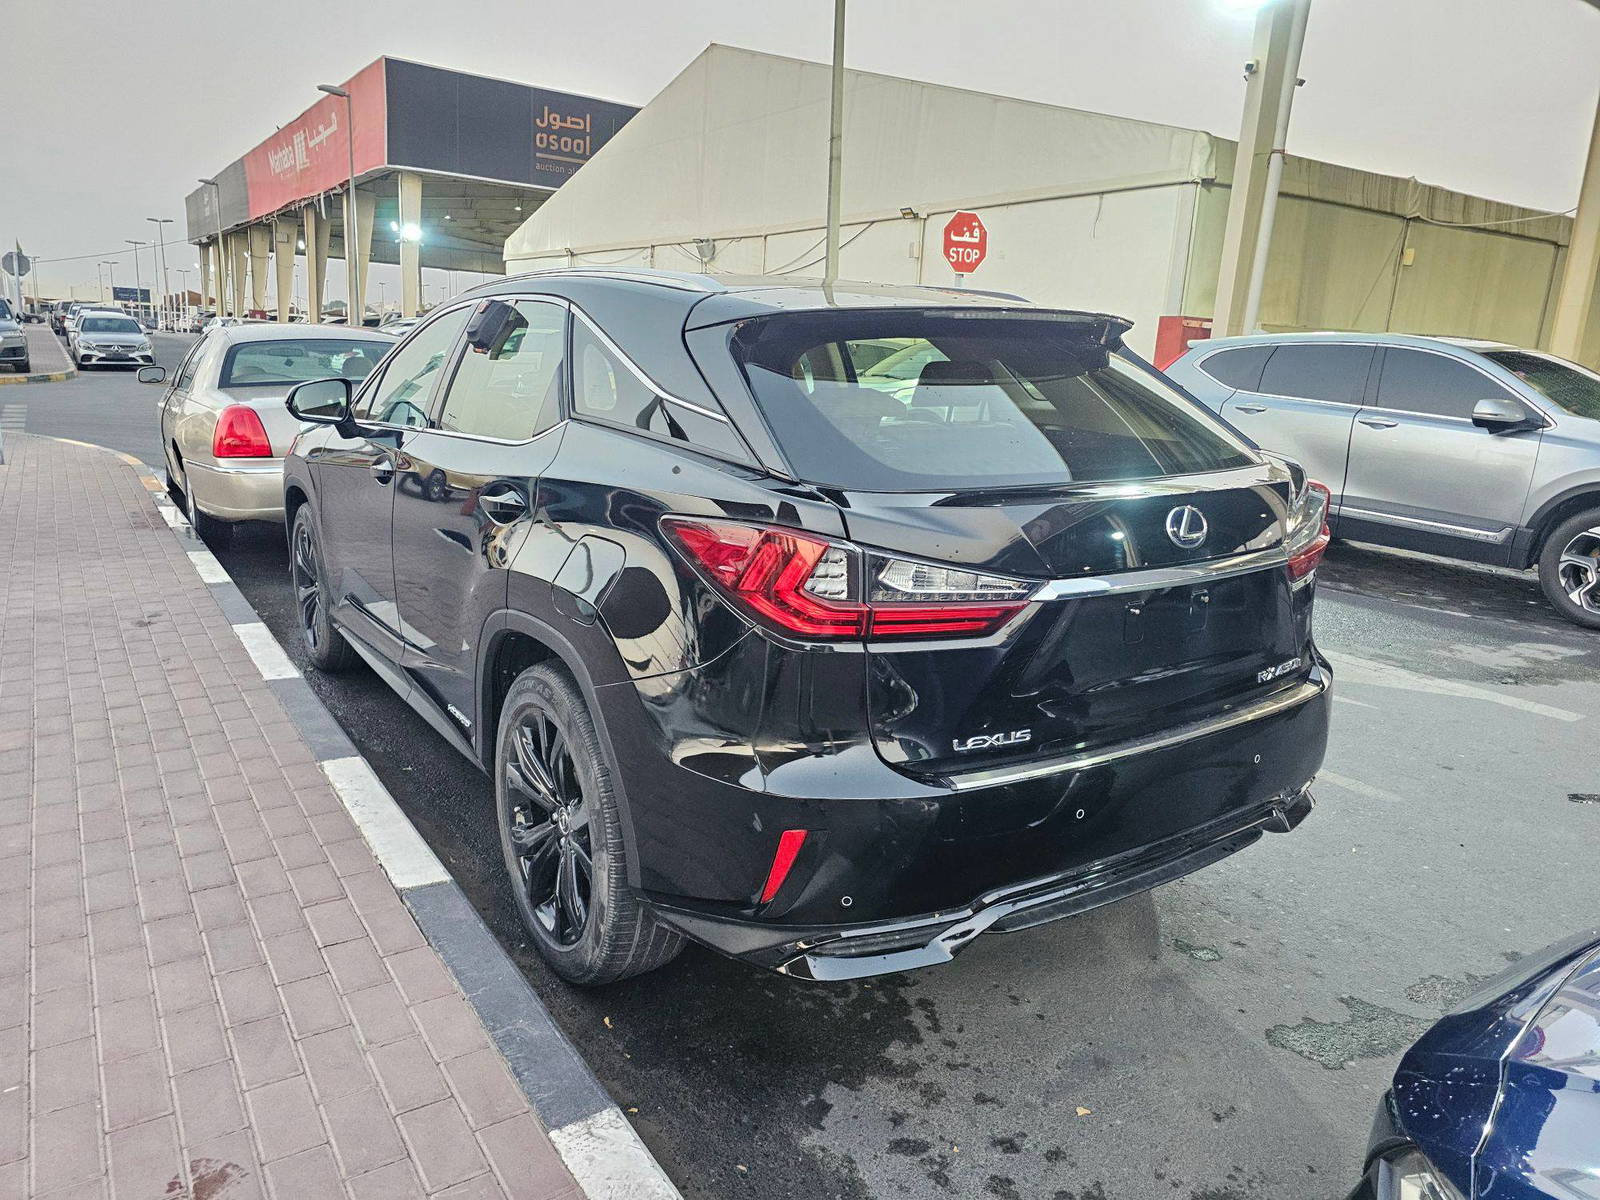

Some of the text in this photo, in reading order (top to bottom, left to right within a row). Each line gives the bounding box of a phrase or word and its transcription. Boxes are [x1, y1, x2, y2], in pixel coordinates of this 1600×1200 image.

[536, 132, 591, 155] osool
[535, 163, 565, 174] auction
[950, 221, 980, 243] قف
[949, 247, 980, 264] STOP
[952, 728, 1032, 752] LEXUS
